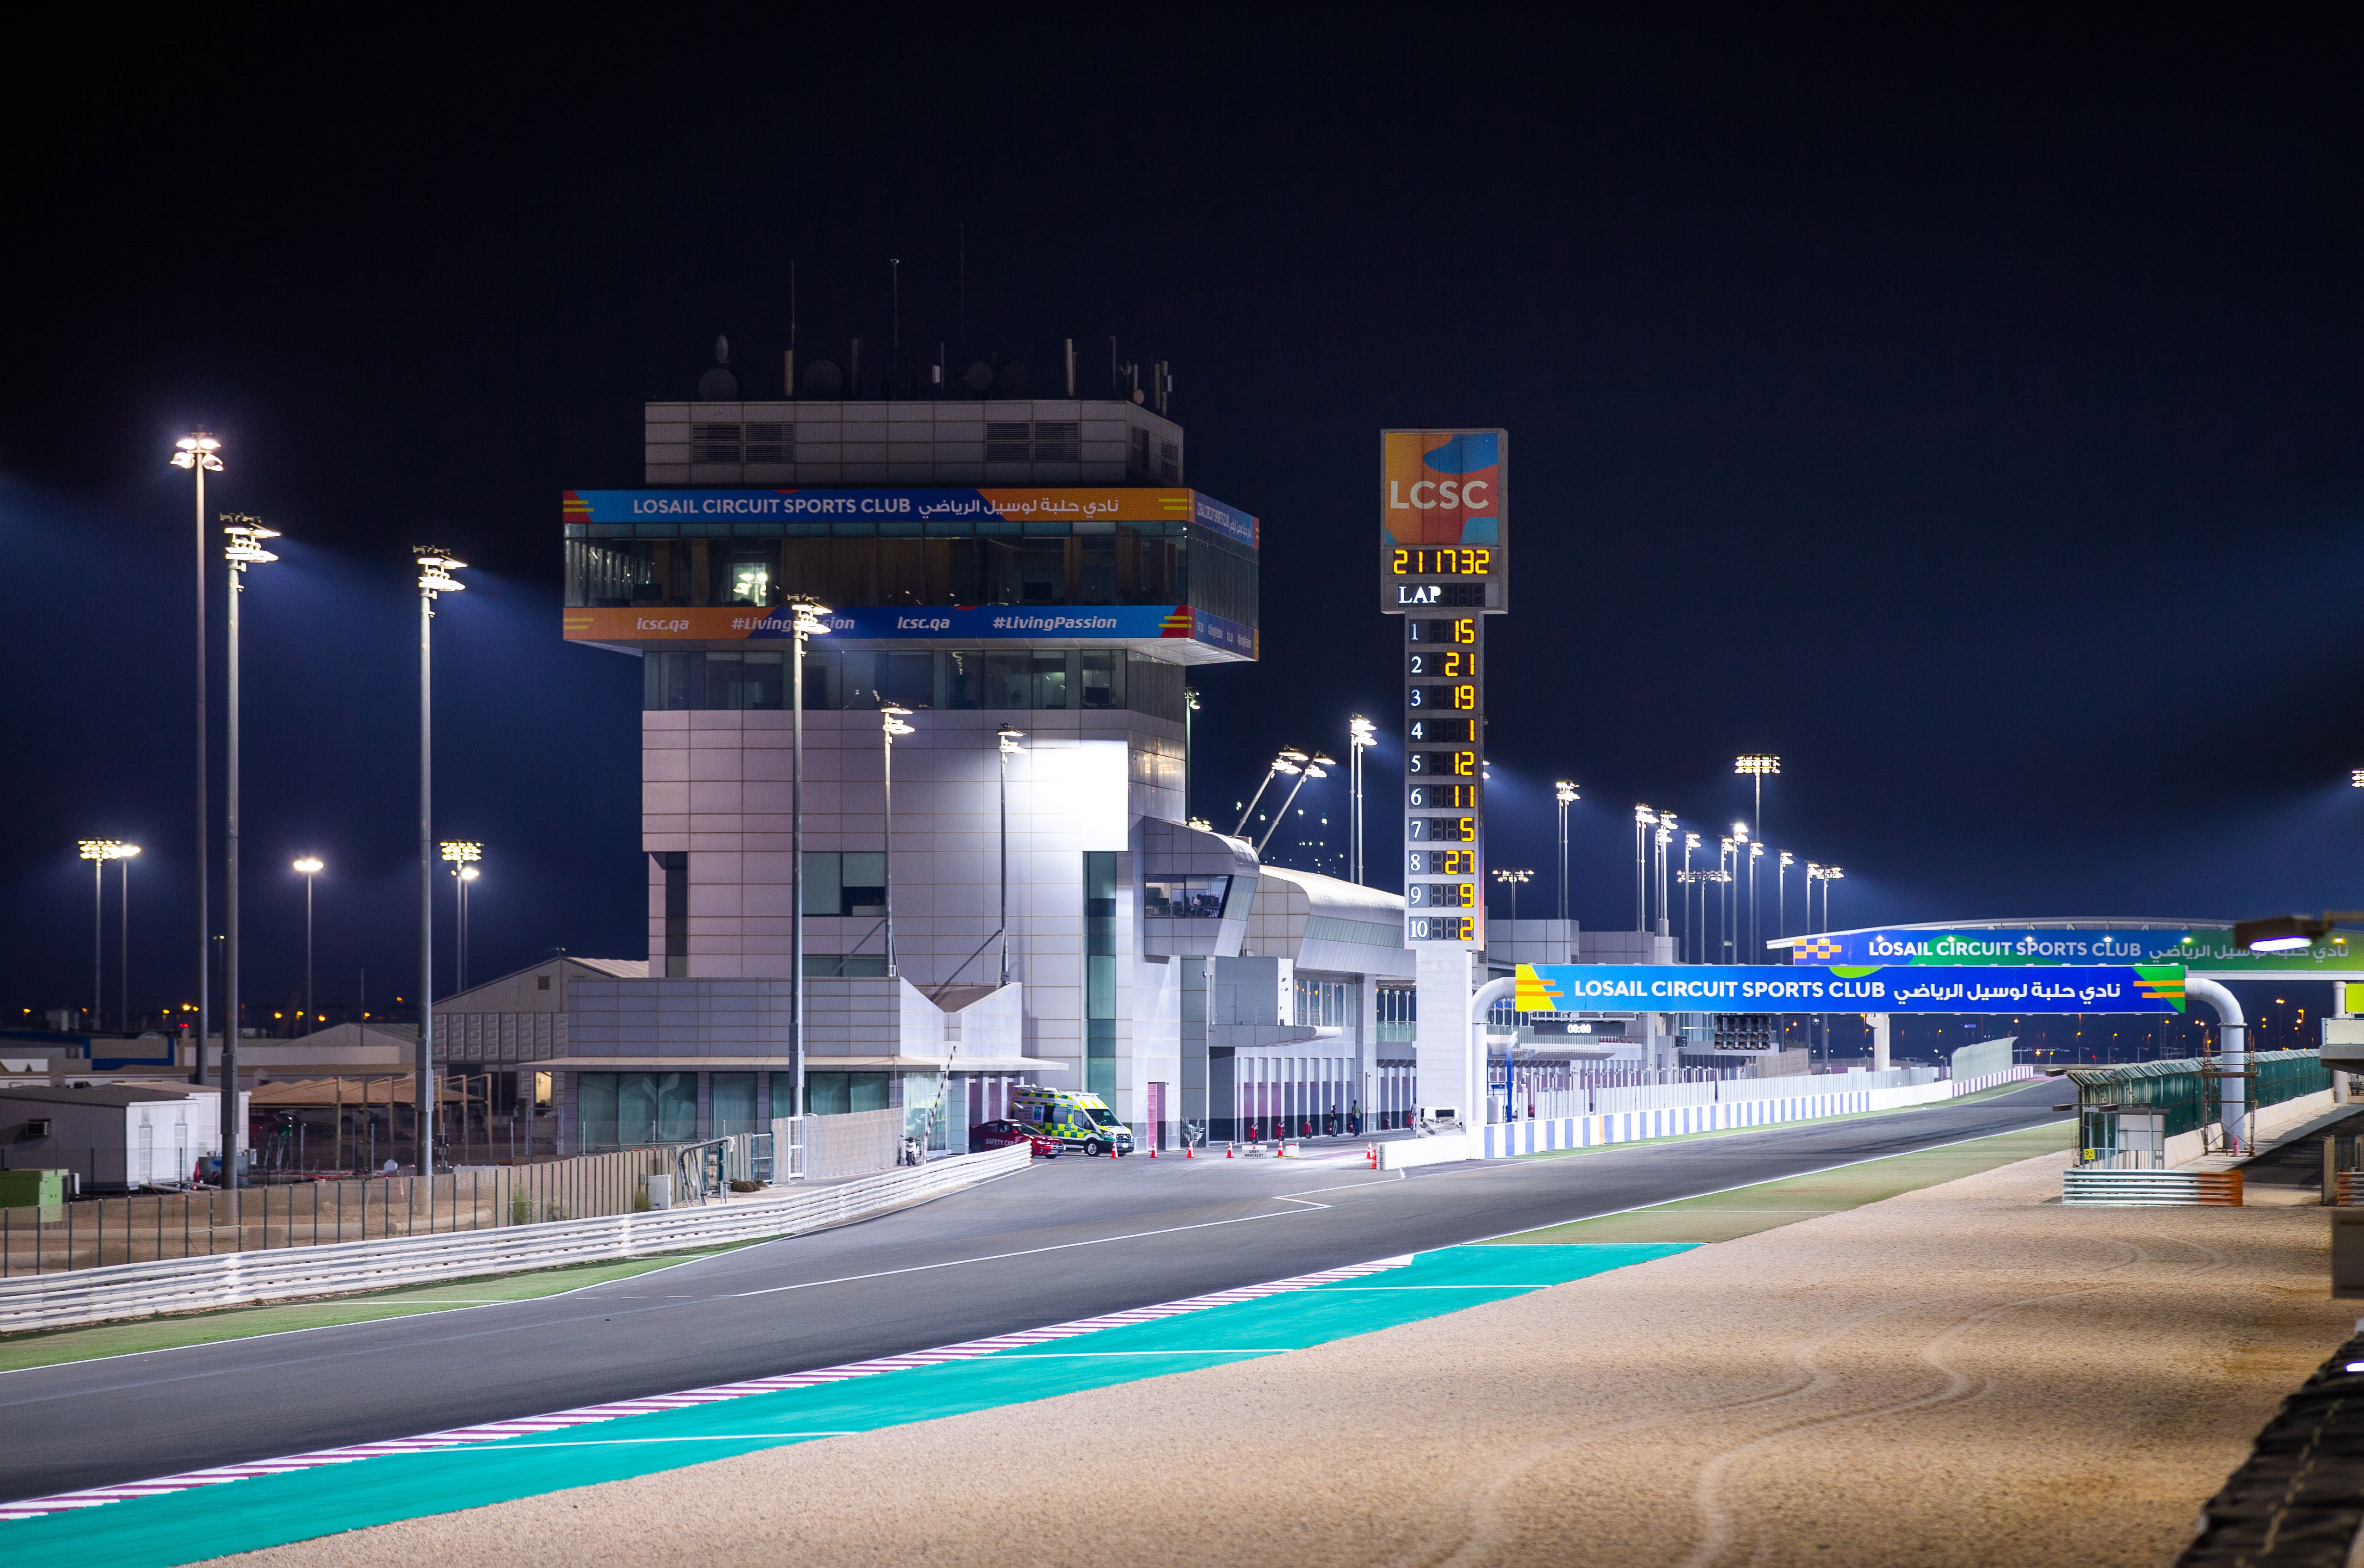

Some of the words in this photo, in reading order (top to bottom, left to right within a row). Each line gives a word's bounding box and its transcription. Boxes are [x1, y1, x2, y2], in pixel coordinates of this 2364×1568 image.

[1391, 481, 1489, 509] LCSC
[634, 500, 699, 514] LOSAIL
[703, 499, 780, 513] CIRCUIT
[784, 499, 856, 513] SPORTS
[861, 498, 910, 512] CLUB
[919, 500, 980, 519] الرياضي
[983, 500, 1037, 515] لوسيل
[1040, 497, 1080, 514] حلبة
[1083, 500, 1119, 519] نادي
[1399, 586, 1441, 603] LAP
[636, 617, 689, 632] lcsc.qa
[897, 617, 950, 631] lcsc.qa
[993, 616, 1117, 631] #LivingPassion
[1411, 623, 1418, 640] 1
[1455, 619, 1475, 643] 15
[1411, 656, 1422, 673] 2
[1445, 652, 1475, 677] 21
[1411, 690, 1421, 706] 3
[1455, 685, 1475, 710] 19
[1411, 722, 1423, 739] 4
[1469, 719, 1475, 741] 1
[1411, 755, 1420, 772] 5
[1455, 751, 1475, 776] 12
[1411, 788, 1422, 805] 6
[1455, 785, 1475, 808] 11
[1411, 821, 1422, 838] 7
[1460, 817, 1475, 842] 5
[1410, 854, 1420, 871] 8
[1445, 850, 1475, 875] 27
[1410, 887, 1421, 904] 9
[1460, 883, 1475, 907] 9
[1410, 920, 1428, 938] 10
[1460, 916, 1475, 941] 2
[1869, 942, 1933, 956] LOSAIL
[1936, 942, 2012, 956] CIRCUIT
[2016, 942, 2087, 956] SPORTS
[2092, 942, 2142, 957] CLUB
[2149, 945, 2211, 963] الرياضي
[2313, 945, 2349, 963] نادي
[1574, 980, 1648, 997] LOSAIL
[1651, 981, 1738, 997] CIRCUIT
[1742, 981, 1824, 998] SPORTS
[1828, 982, 1886, 998] CLUB
[1894, 983, 1963, 1005] الرياضي
[1967, 984, 2028, 1001] لوسيل
[2031, 982, 2076, 1001] حلبة
[2079, 983, 2121, 1005] نادي
